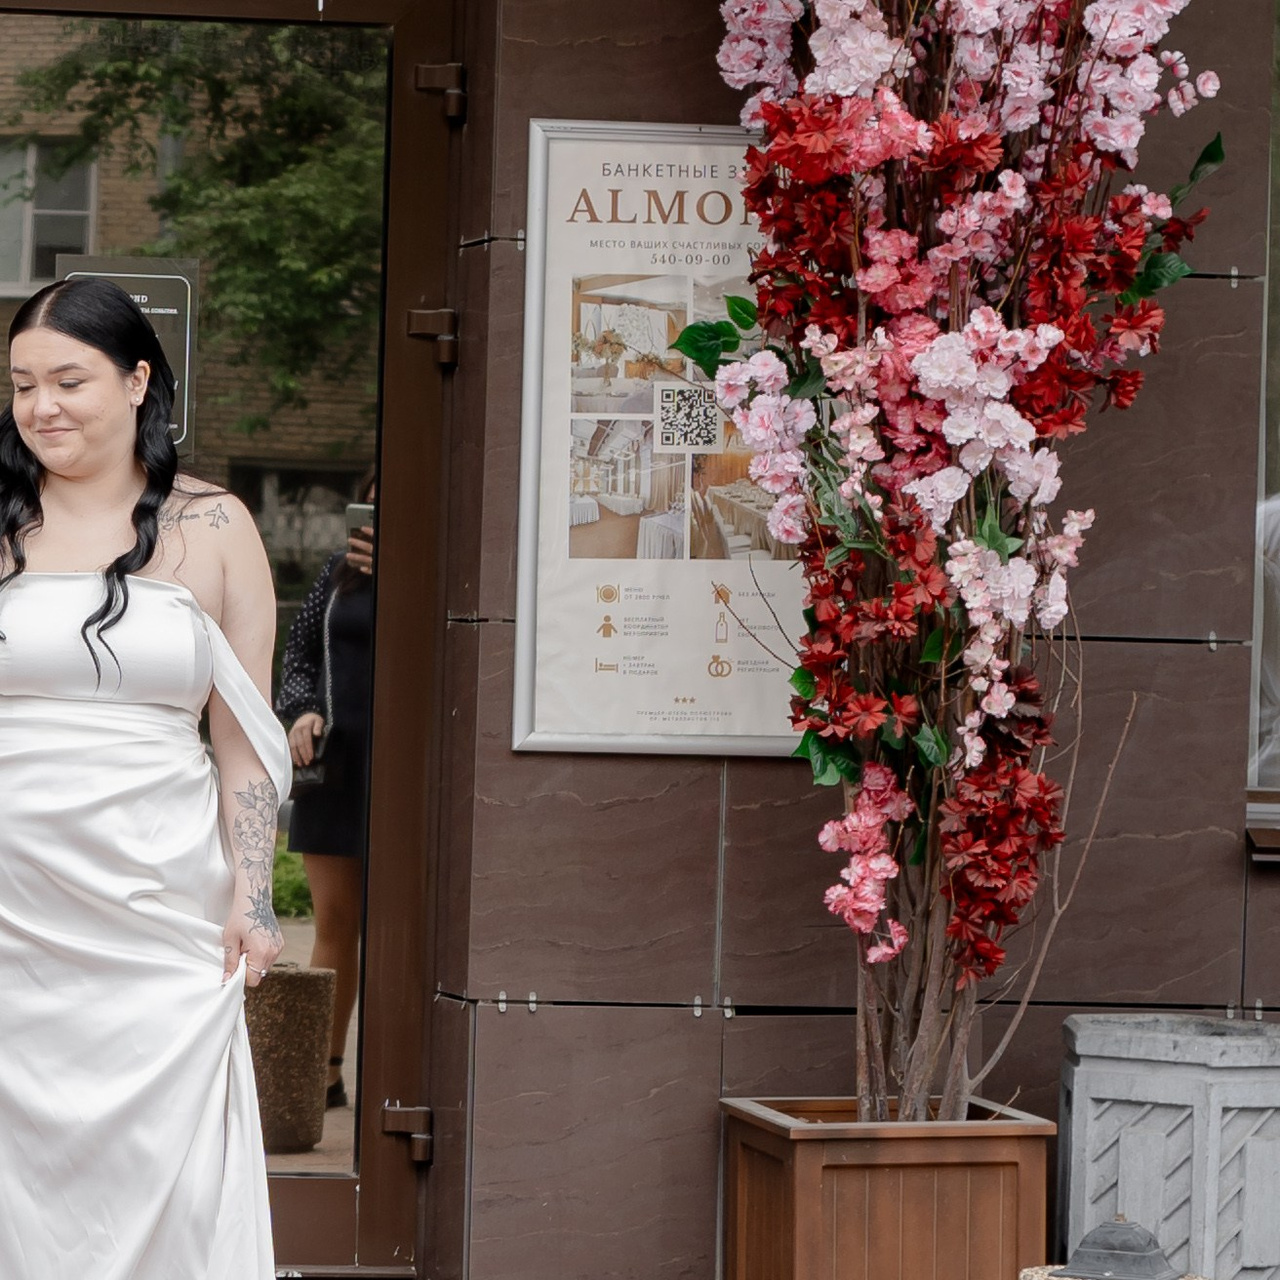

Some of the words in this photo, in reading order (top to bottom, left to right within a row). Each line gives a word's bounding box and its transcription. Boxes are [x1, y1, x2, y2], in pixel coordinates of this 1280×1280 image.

[601, 162, 719, 179] БАНКЕТНЫЕ
[589, 239, 625, 249] МЕСТО
[630, 240, 669, 250] ВАШИХ
[671, 240, 743, 250] СЧАСТЛИВЫХ
[650, 252, 732, 266] 540-09-00
